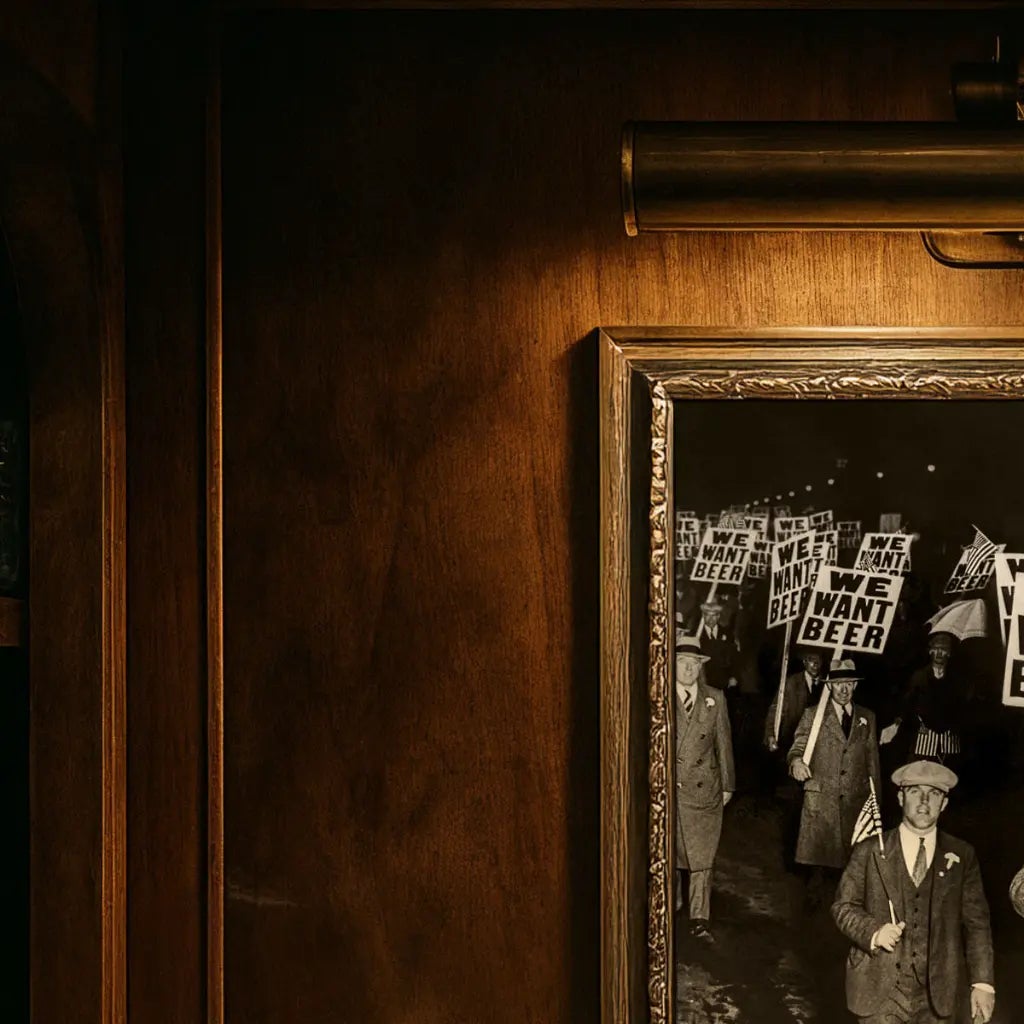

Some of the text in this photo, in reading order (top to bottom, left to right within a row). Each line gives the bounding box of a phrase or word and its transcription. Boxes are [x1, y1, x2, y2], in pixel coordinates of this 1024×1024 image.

[713, 531, 749, 547] WE
[870, 536, 906, 550] WE
[702, 545, 749, 563] WANT
[778, 536, 810, 567] WE
[694, 562, 743, 580] BEER
[774, 558, 813, 596] WANT
[830, 571, 892, 598] WE
[945, 575, 990, 592] BEER
[813, 592, 893, 624] WANT
[802, 617, 885, 649] BEER
